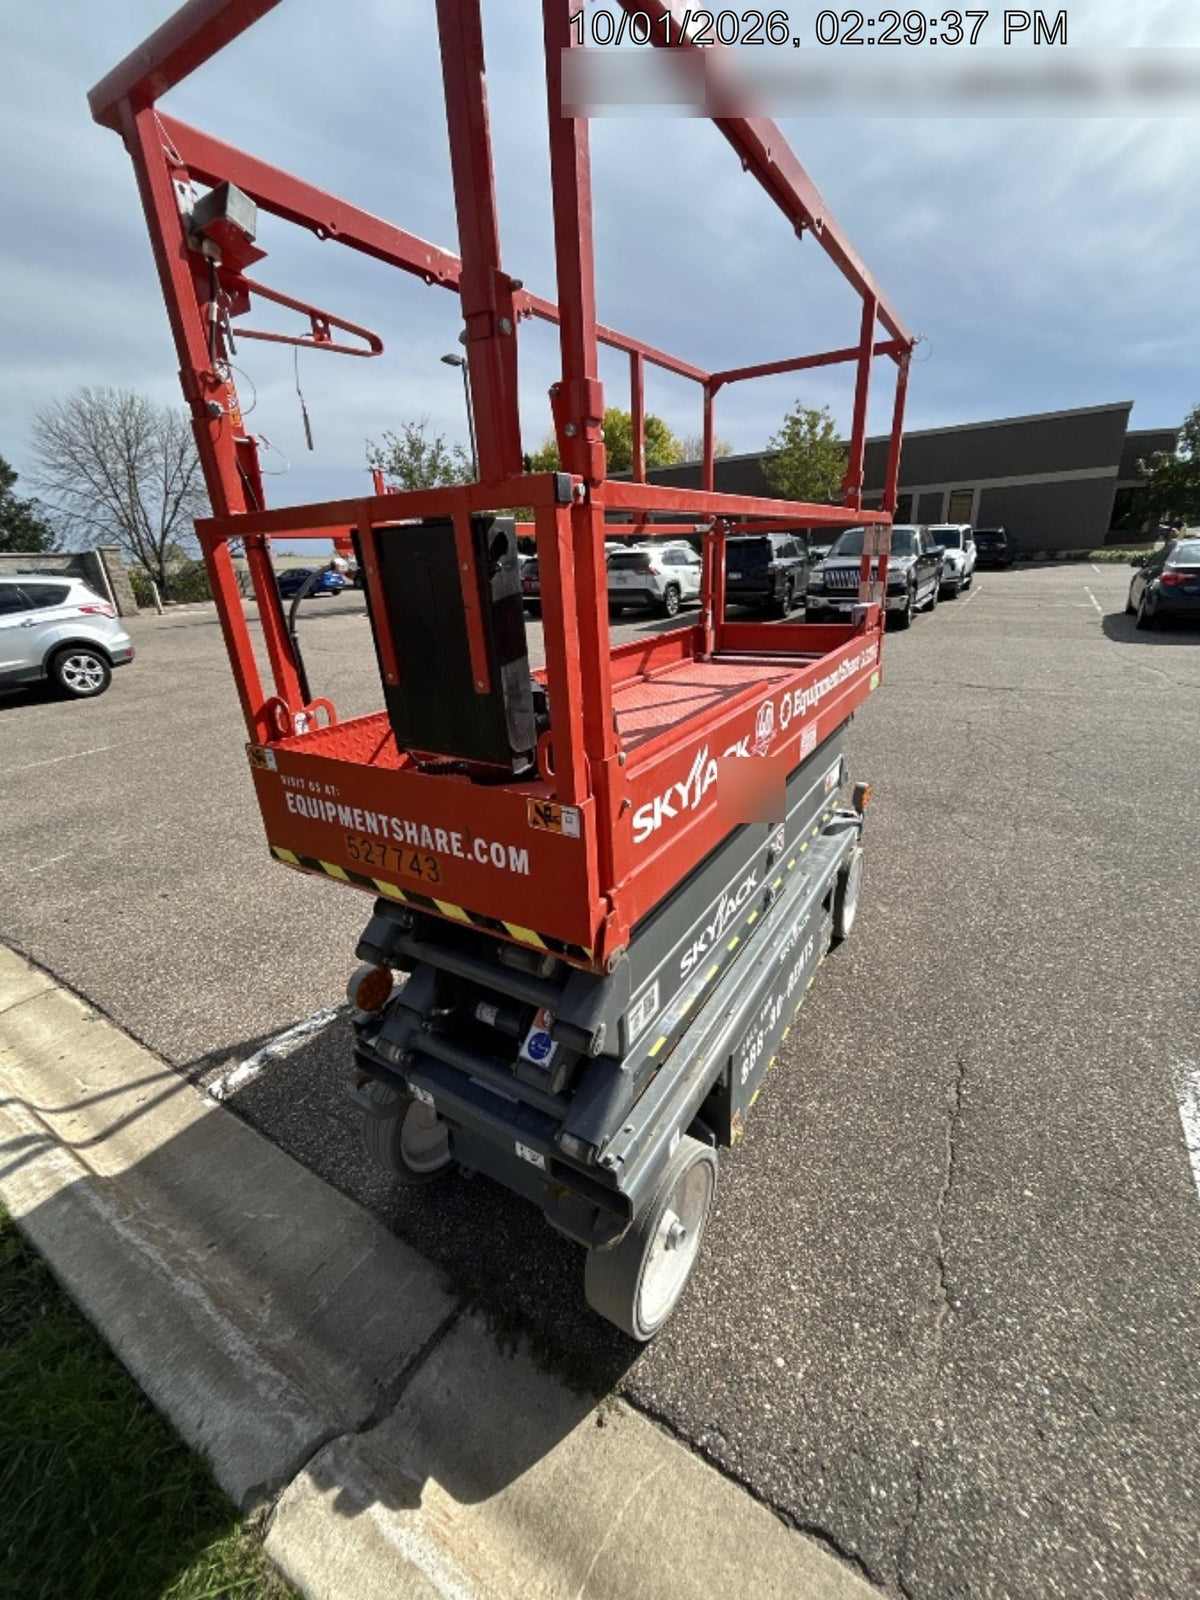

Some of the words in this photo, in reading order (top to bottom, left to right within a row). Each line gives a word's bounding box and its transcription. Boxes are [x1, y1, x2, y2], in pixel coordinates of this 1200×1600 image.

[285, 791, 531, 876] EQUIPMENTSHARE.COM
[346, 834, 441, 883] 527743
[680, 868, 758, 979] SKYJACK
